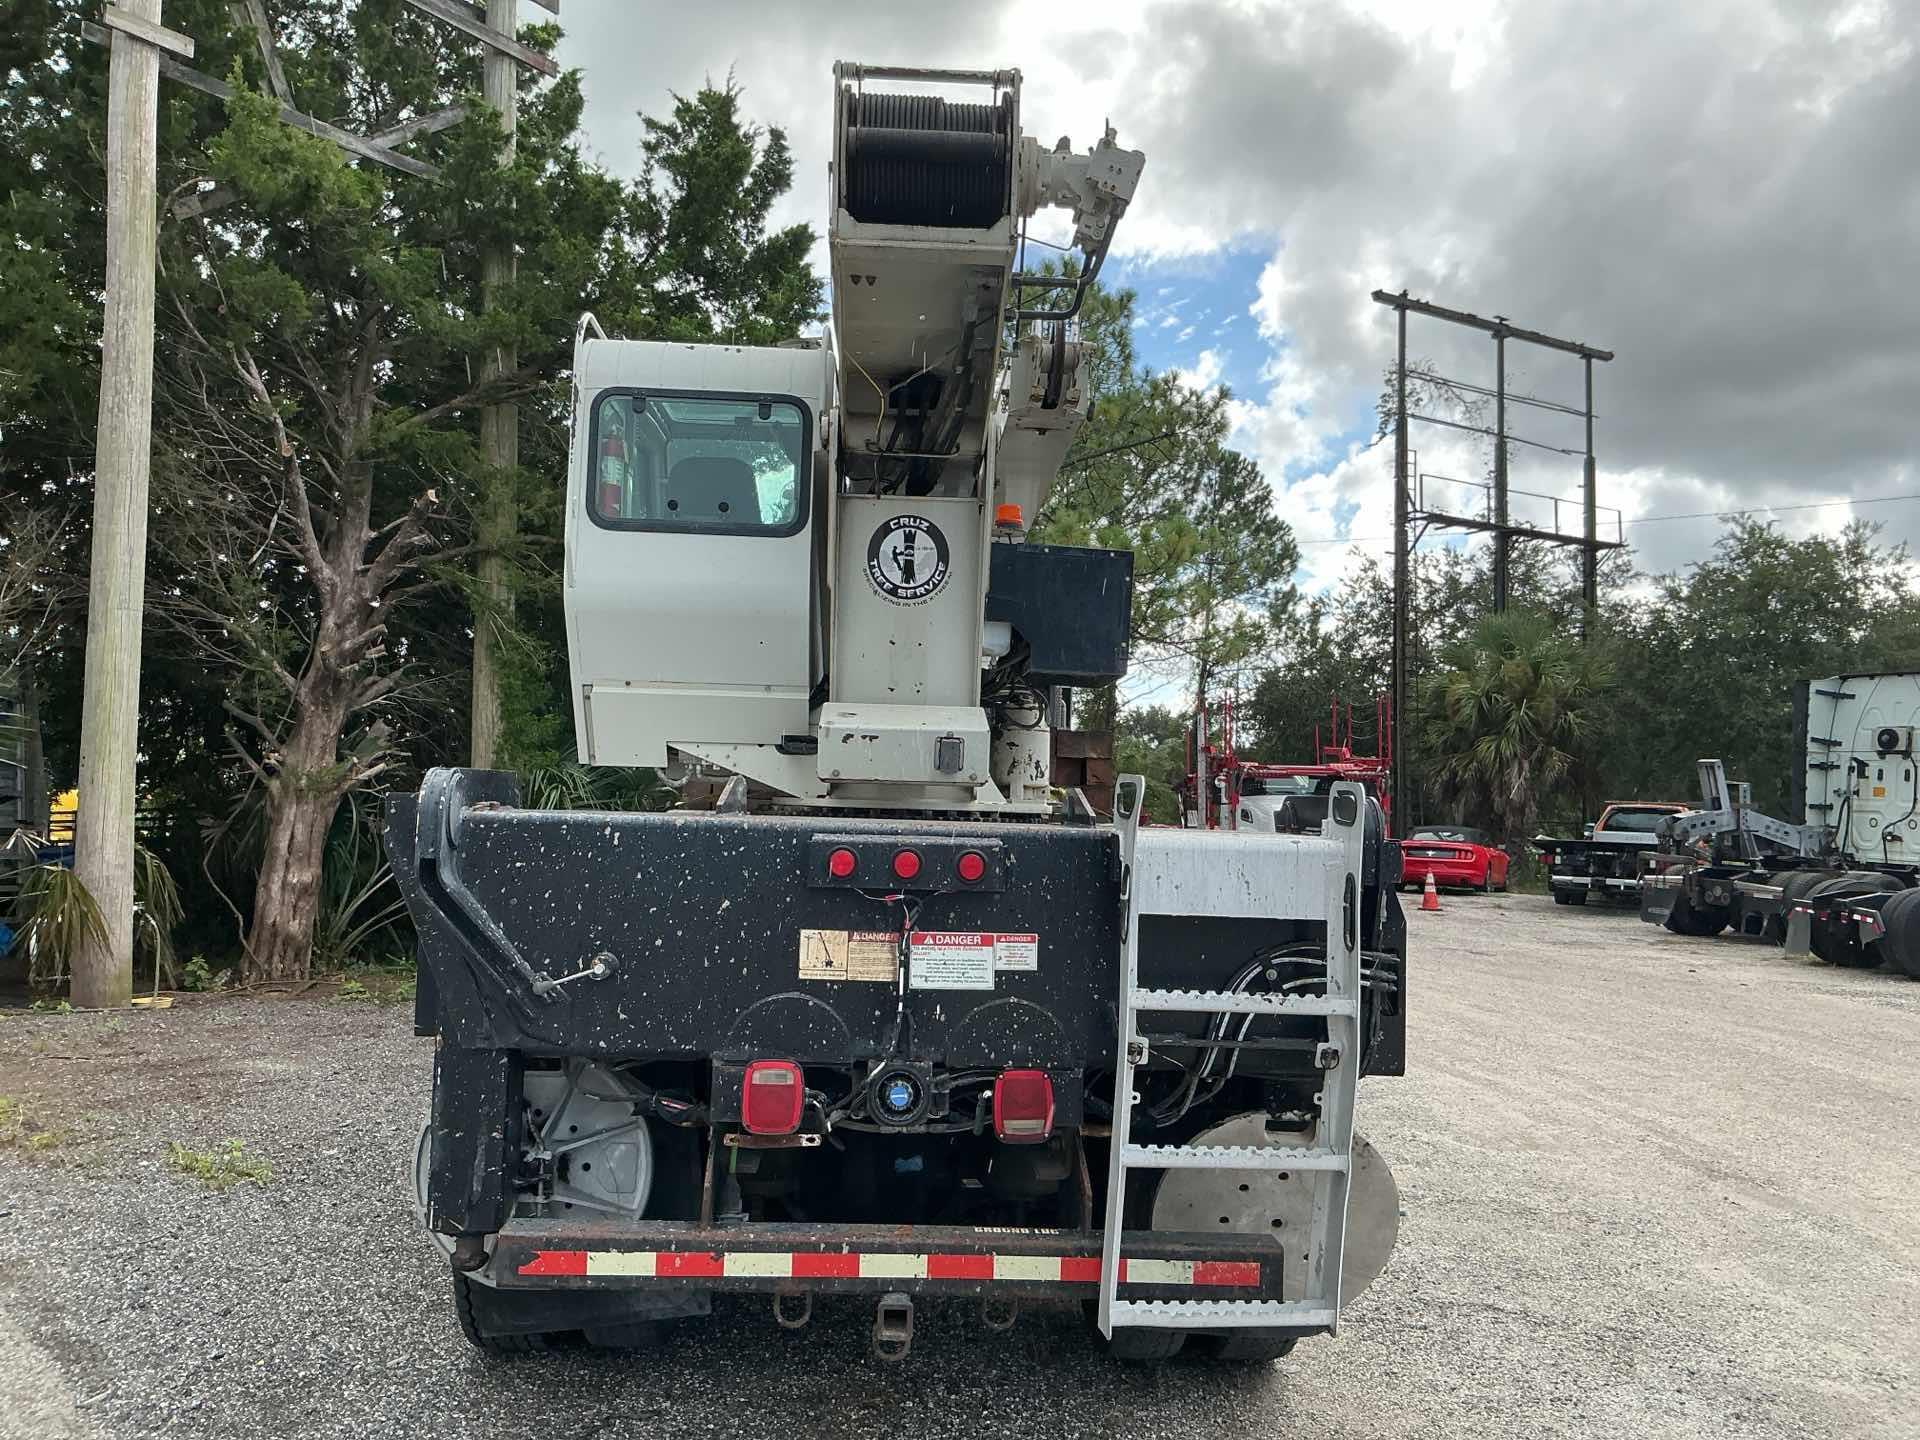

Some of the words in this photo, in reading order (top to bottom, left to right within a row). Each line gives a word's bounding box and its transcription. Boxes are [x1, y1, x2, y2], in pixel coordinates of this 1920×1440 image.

[890, 517, 930, 531] CRUZ
[870, 558, 893, 591] TREE
[897, 561, 945, 597] SERVICE
[935, 935, 982, 945] DANGER
[974, 1226, 1030, 1234] GROUND
